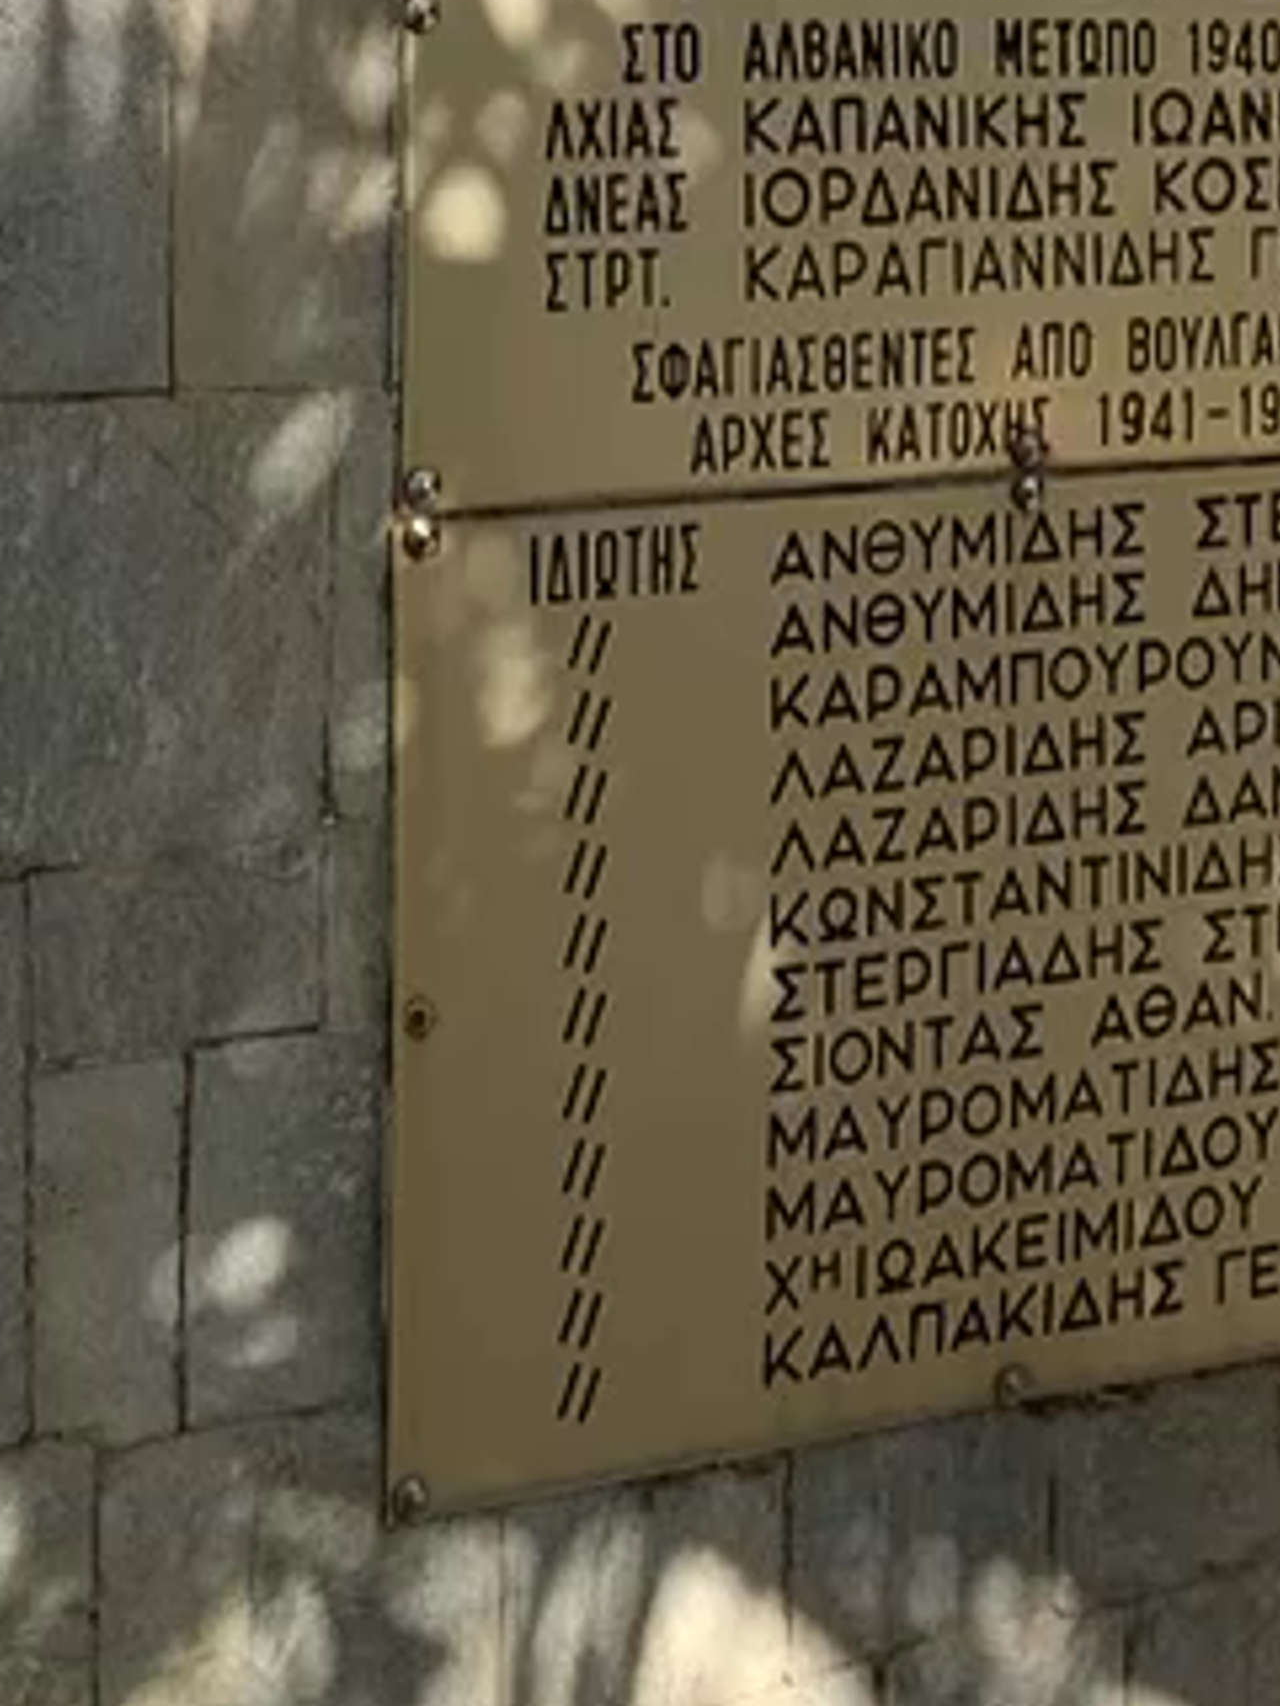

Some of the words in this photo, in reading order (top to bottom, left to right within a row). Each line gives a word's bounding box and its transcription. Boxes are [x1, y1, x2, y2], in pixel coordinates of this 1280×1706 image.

[622, 20, 701, 84] ΣΤΟ
[743, 18, 960, 82] ΑΛΒΑΝΙΚΟ
[994, 16, 1157, 79] ΜΕΤΩΠΟ
[742, 89, 1085, 156] ΚΑΠΑΝΙΚΗΣ
[742, 160, 1116, 231] ΙΟΡΔΑΝΙΔΗΣ
[743, 228, 1216, 304] ΚΑΡΑΓΙΑΝΝΙΔΗΣ
[631, 324, 977, 404] ΣΦΑΓΙΑΣΘΕΝΤΕΣ
[1010, 319, 1093, 382] ΑΠΟ
[691, 406, 831, 476] ΑΡΧΕΣ
[527, 522, 701, 608] ΙΔΙΩΤΗΣ
[769, 500, 1147, 586] ΑΝΘΥΜΙΔΗΣ
[769, 568, 1147, 660] ΑΝΘΥΜΙΔΗΣ
[769, 708, 1147, 806] ΛΑΖΑΡΙΔΗΣ
[769, 778, 1149, 876] ΛΑΖΑΡΙΔΗΣ
[769, 916, 1163, 1024] ΣΤΕΡΓΙΑΔΗΣ
[769, 1001, 1044, 1097] ΣΙΟΝΤΑΣ
[767, 1036, 1280, 1170] ΜΑΥΡΟΜΑΤΙΔΗΣ
[765, 1104, 1280, 1243] ΜΑΥΡΟΜΑΤΙΔΟΥ
[761, 1257, 1187, 1390] ΚΑΛΠΑΚΙΔΗΣ
